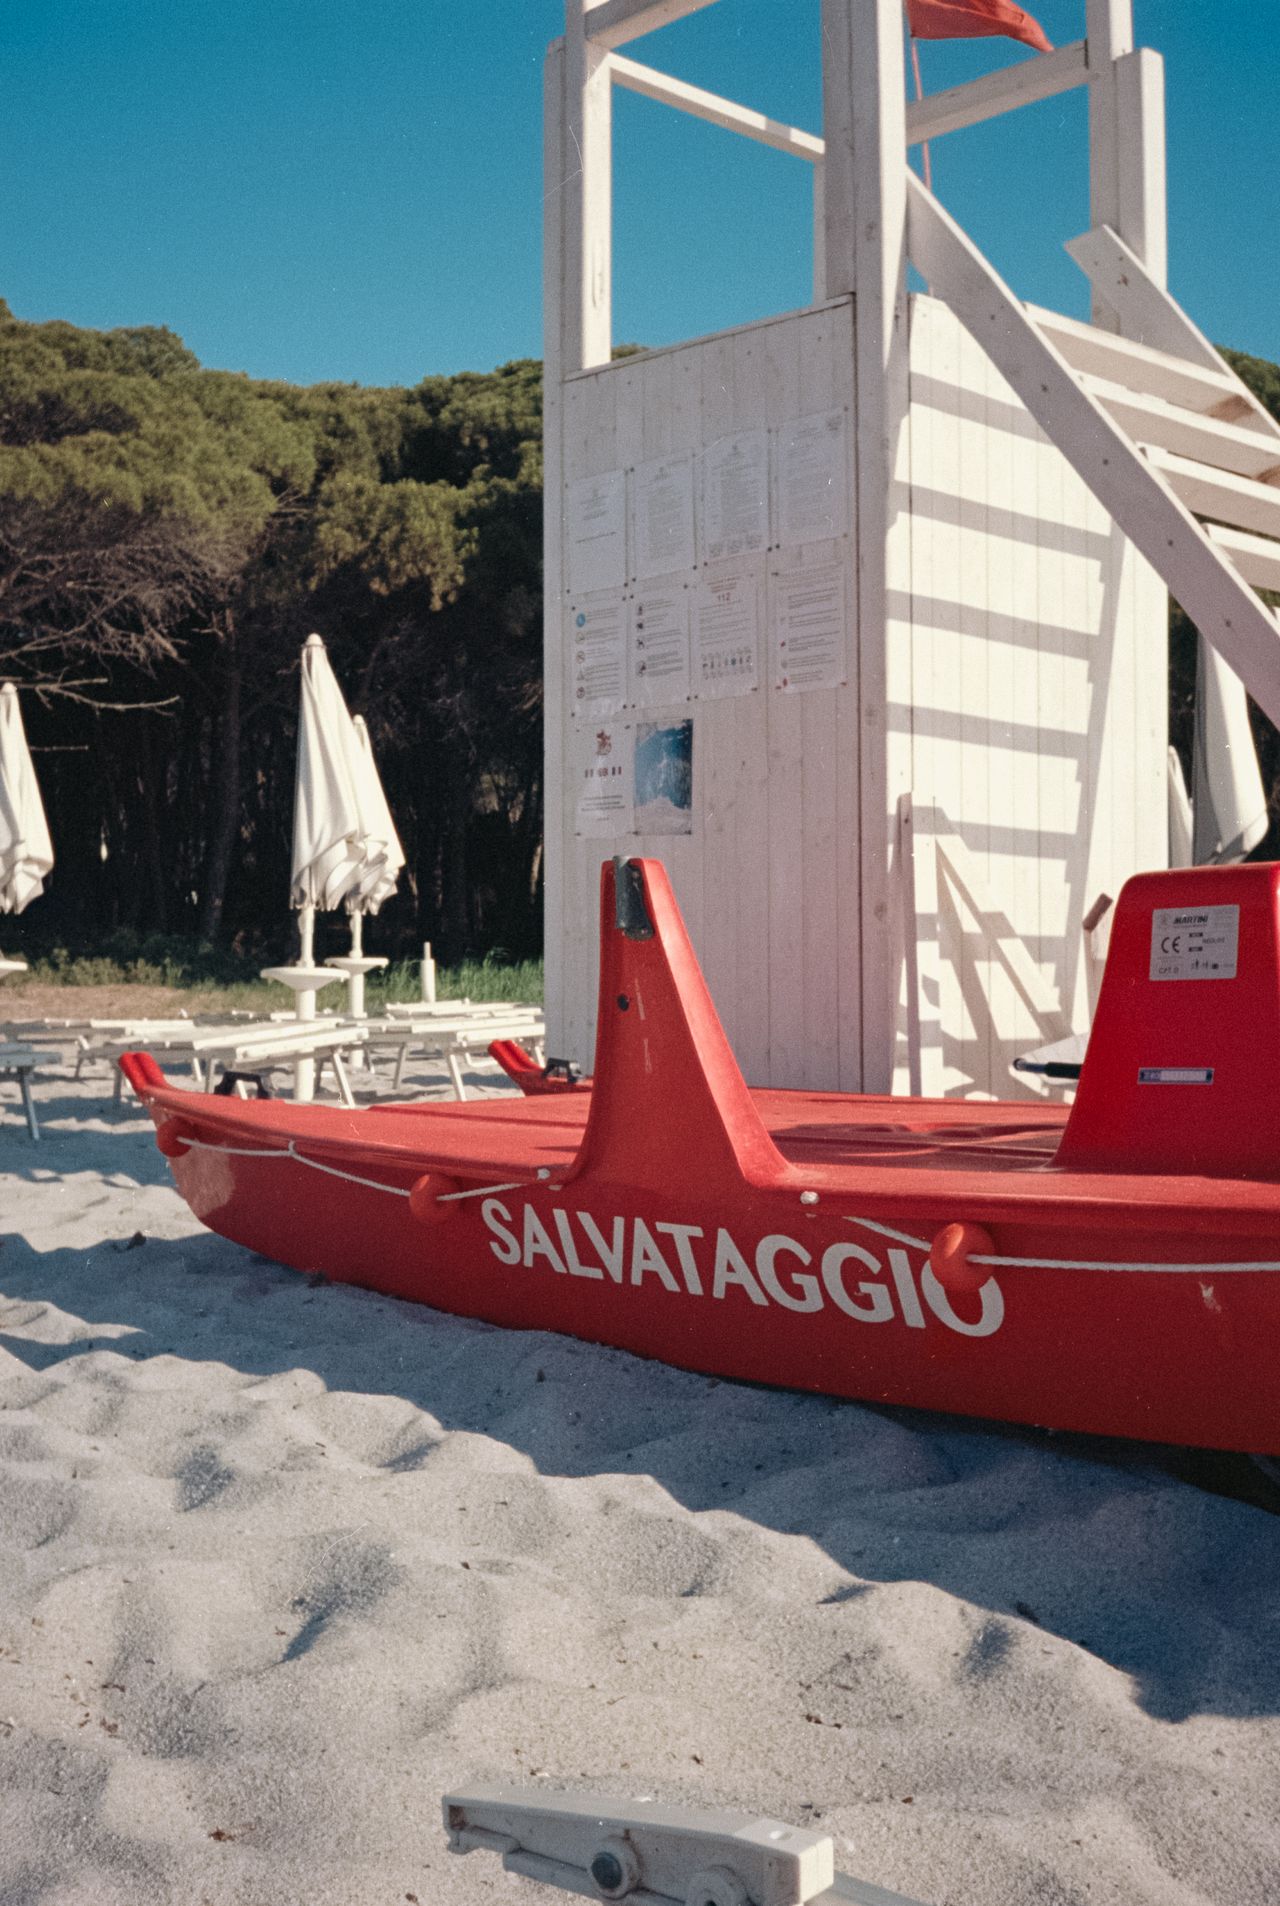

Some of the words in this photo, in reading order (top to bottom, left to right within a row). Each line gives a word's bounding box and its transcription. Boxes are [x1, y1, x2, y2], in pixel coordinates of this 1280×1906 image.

[1173, 915, 1208, 925] MARTINI
[1161, 936, 1181, 954] CE
[482, 1198, 1005, 1337] SALVATAGGIO
